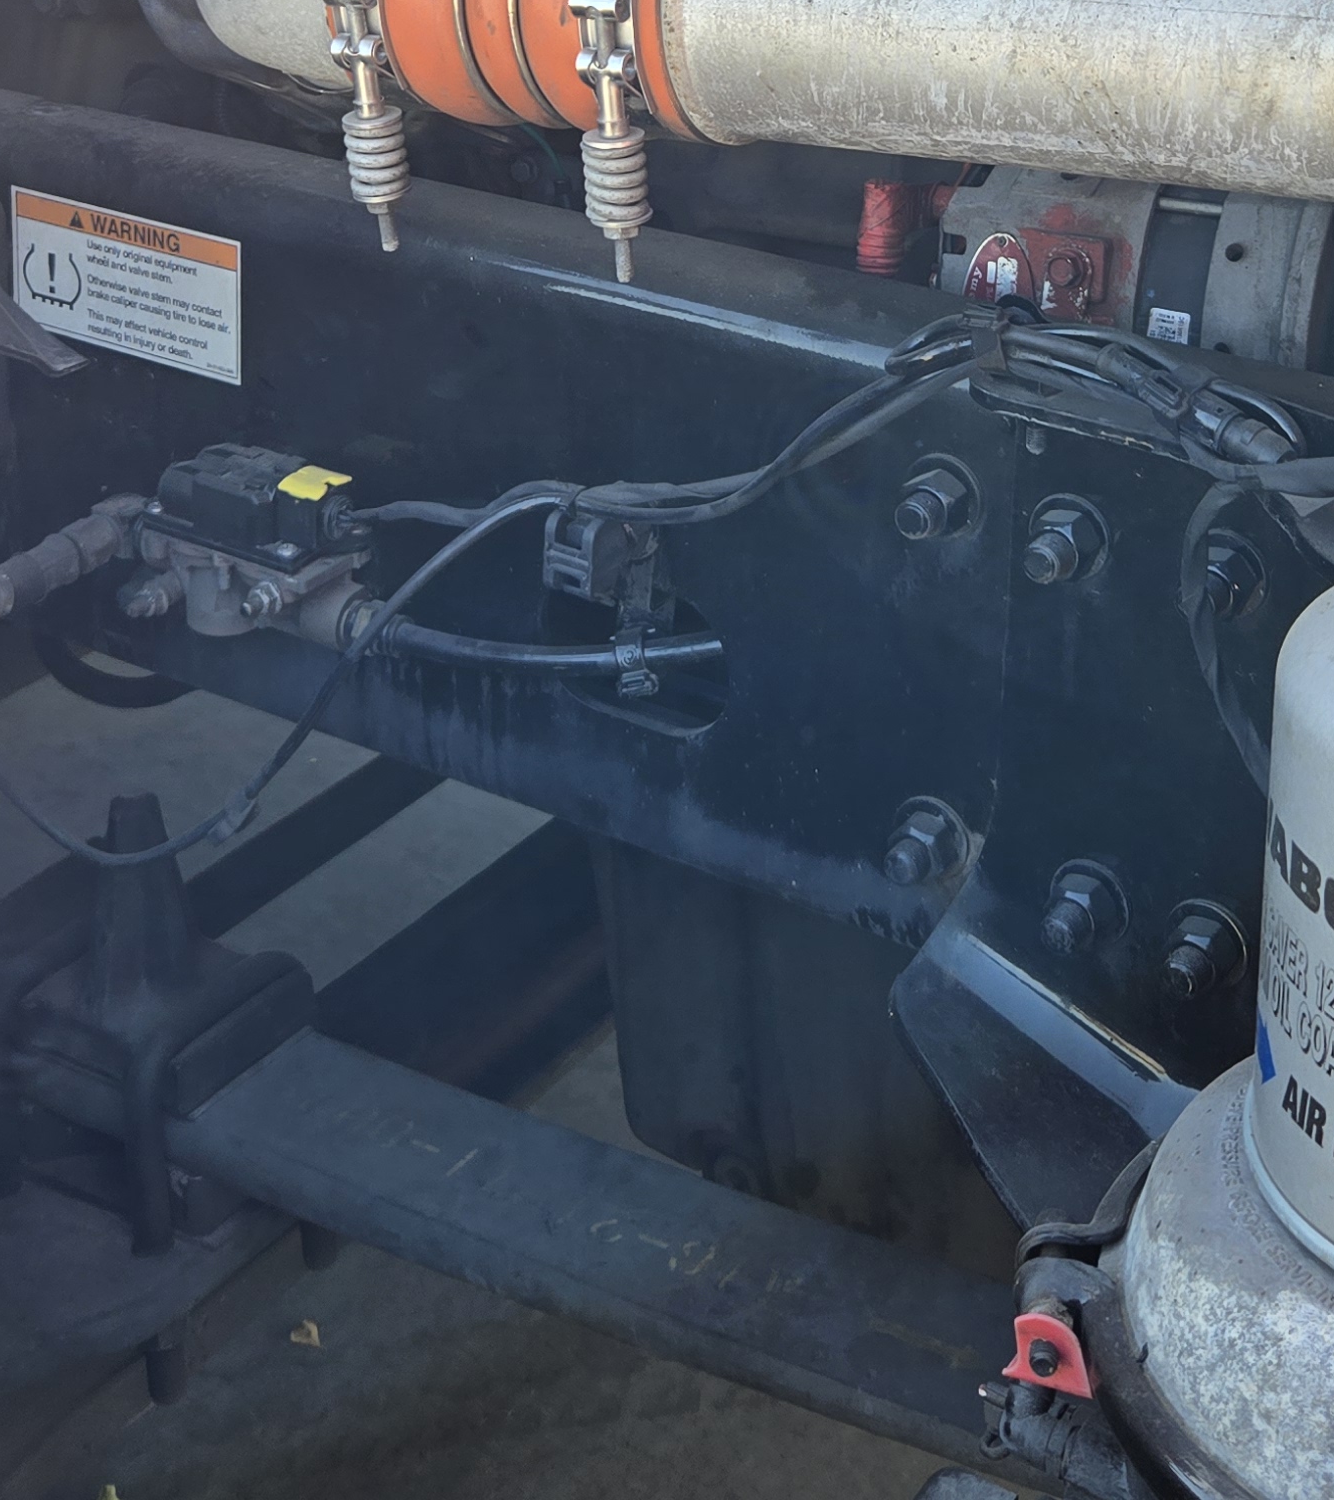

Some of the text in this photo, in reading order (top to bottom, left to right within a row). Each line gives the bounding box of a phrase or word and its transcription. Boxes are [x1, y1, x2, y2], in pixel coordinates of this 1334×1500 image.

[89, 212, 181, 254] WARNING
[86, 238, 198, 277] Use only original equipment
[86, 254, 174, 285] wheel and valve stem.
[87, 273, 223, 320] Otherwise valve stem may contact
[87, 286, 231, 335] brake caliper causing tire to lose air.
[87, 307, 209, 351] This may affect vehicle control
[88, 323, 123, 342] resulting
[124, 331, 132, 343] in
[132, 334, 157, 352] injury
[157, 342, 167, 353] or
[1271, 965, 1293, 1040] OIL
[1281, 1073, 1327, 1149] AIR
